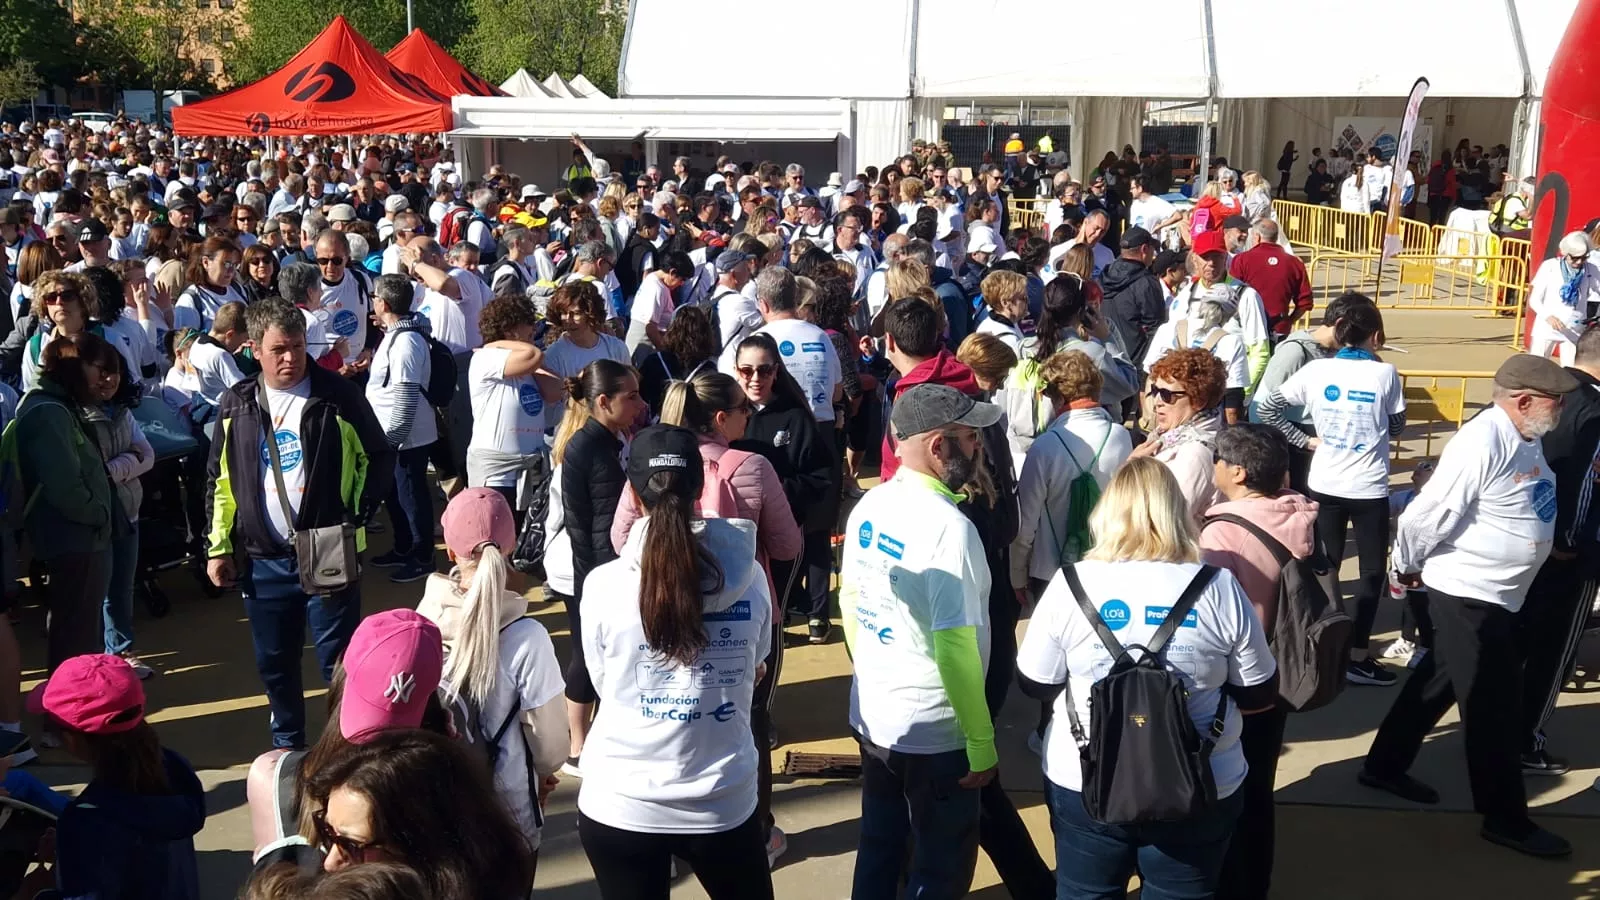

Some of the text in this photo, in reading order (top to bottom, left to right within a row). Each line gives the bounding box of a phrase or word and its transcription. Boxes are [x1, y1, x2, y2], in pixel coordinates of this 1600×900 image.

[275, 115, 373, 130] hoya de huesca
[383, 670, 417, 704] NY
[640, 693, 700, 705] Fundación
